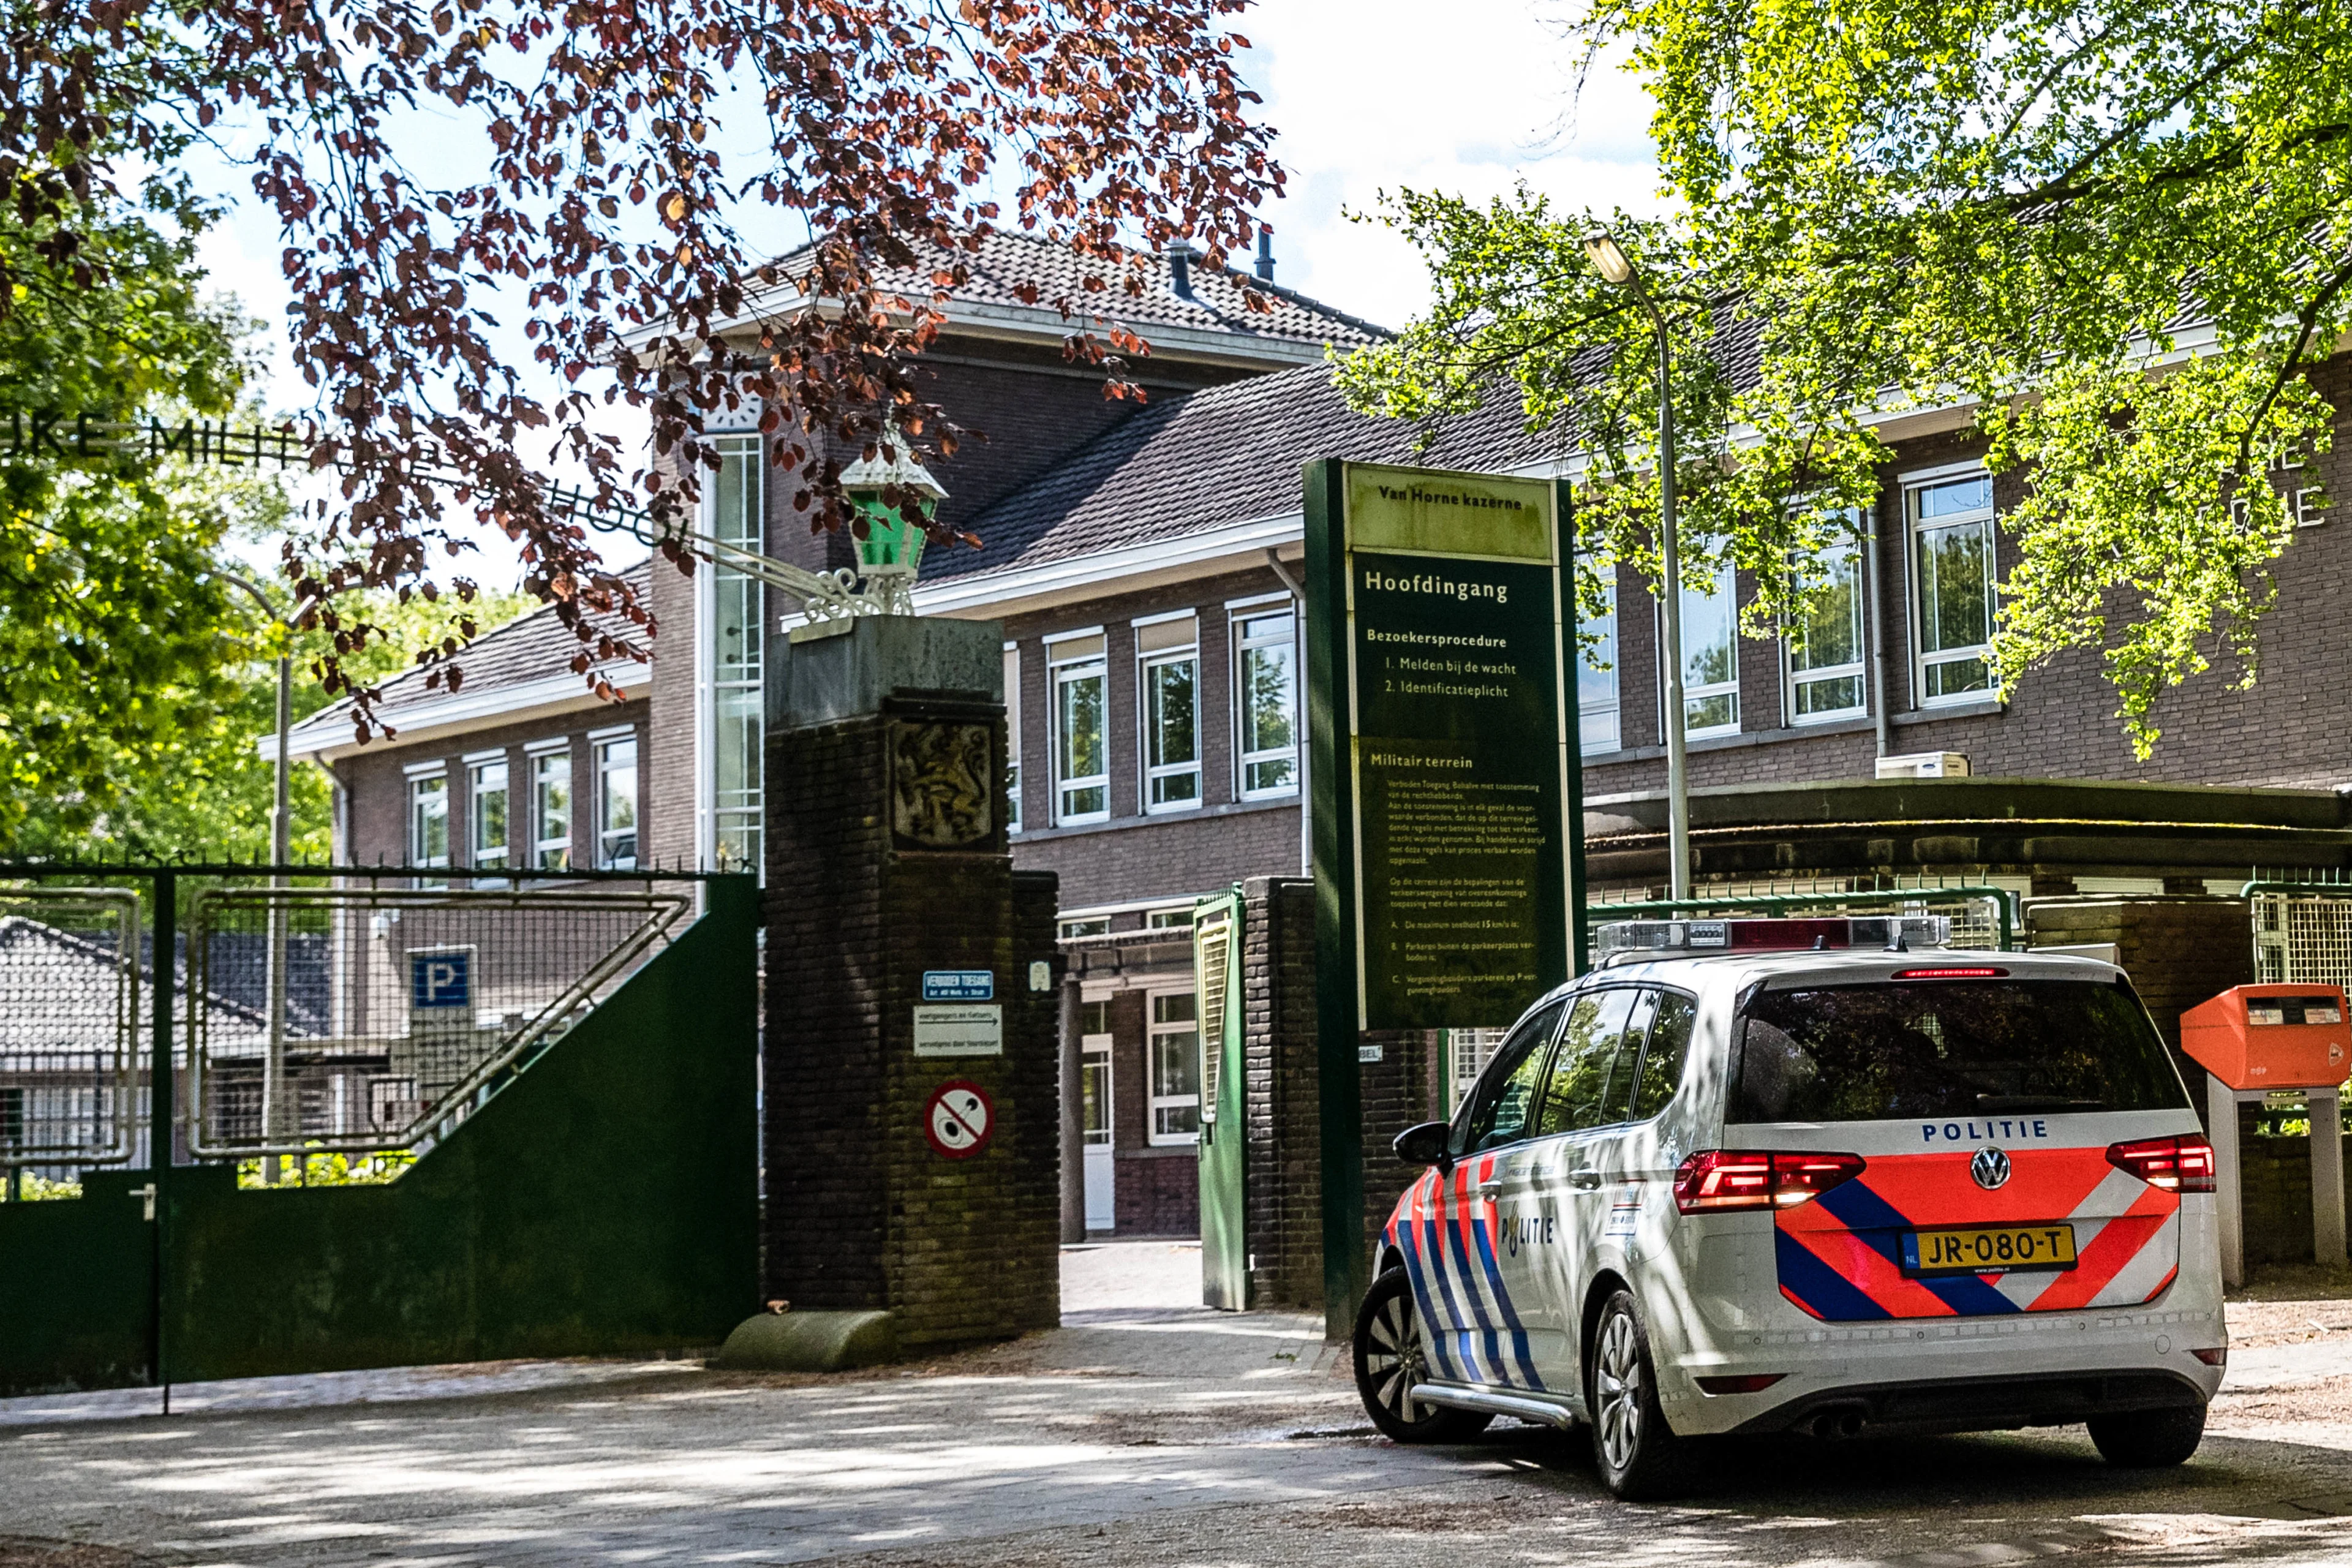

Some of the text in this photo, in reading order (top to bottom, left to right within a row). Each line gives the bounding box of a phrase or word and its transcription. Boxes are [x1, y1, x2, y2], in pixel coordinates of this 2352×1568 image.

[1378, 486, 1523, 511] Van Horne kazerne
[1365, 570, 1509, 604] Hoofdingang
[1366, 628, 1508, 648] Bezoekersprocedure
[1385, 657, 1517, 676] 1. Melden bij de wacht
[1385, 680, 1509, 699] 2. Identificatieplicht
[1371, 753, 1472, 769] Militair terrein
[1482, 920, 1491, 929] 15
[427, 963, 455, 1002] P
[1922, 1120, 2048, 1142] POLITIE
[1906, 1231, 2062, 1264] NL JR-080-T
